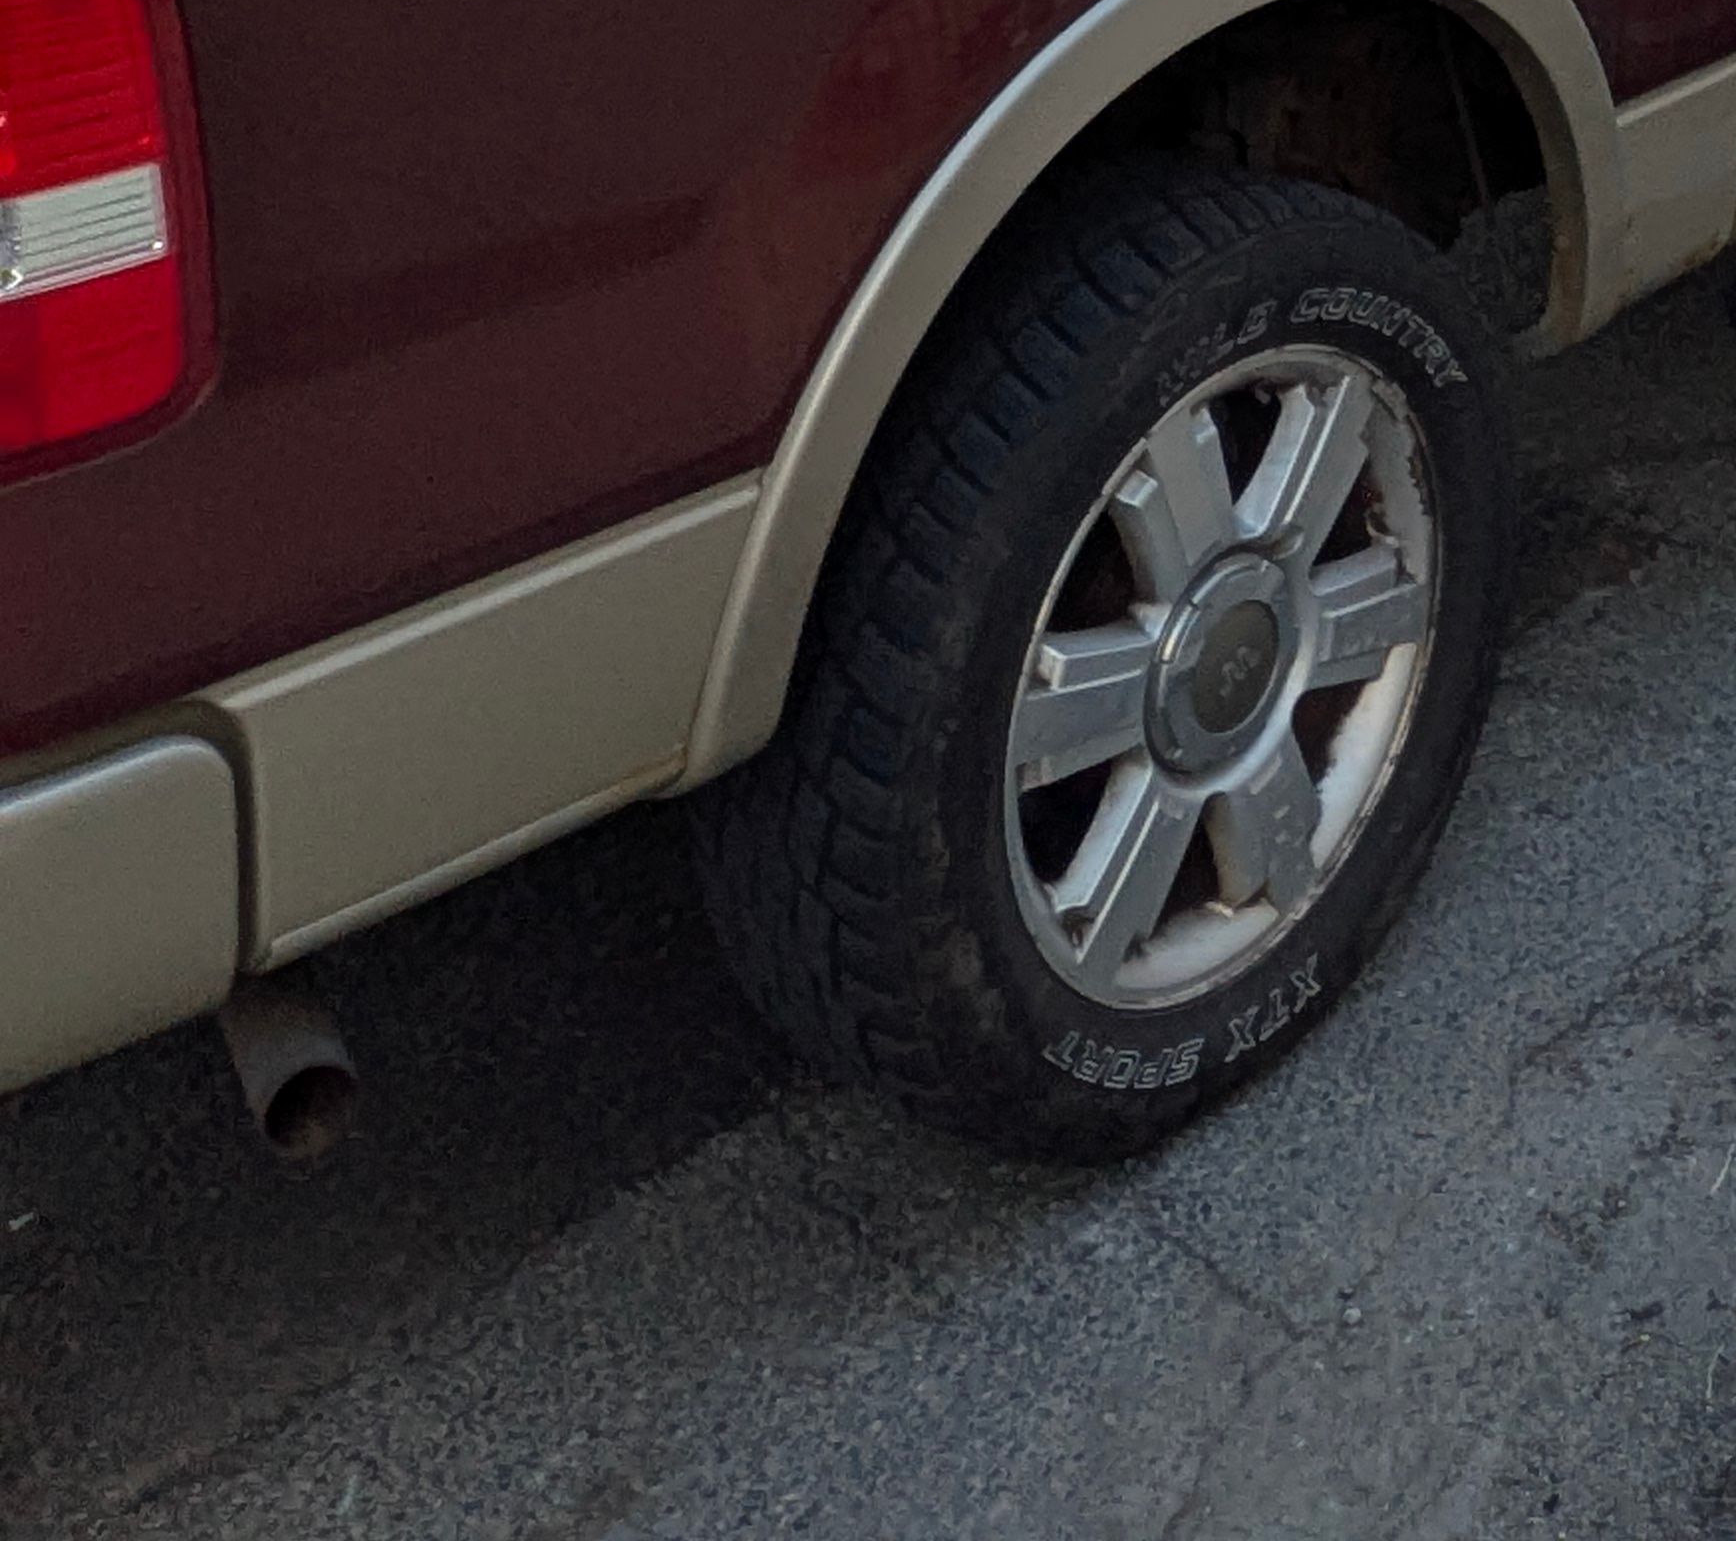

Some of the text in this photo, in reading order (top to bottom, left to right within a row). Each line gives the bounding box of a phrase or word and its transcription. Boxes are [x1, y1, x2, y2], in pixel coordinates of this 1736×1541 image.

[1290, 287, 1469, 388] COUNTRY
[1042, 952, 1321, 1089] XTX SPORT
